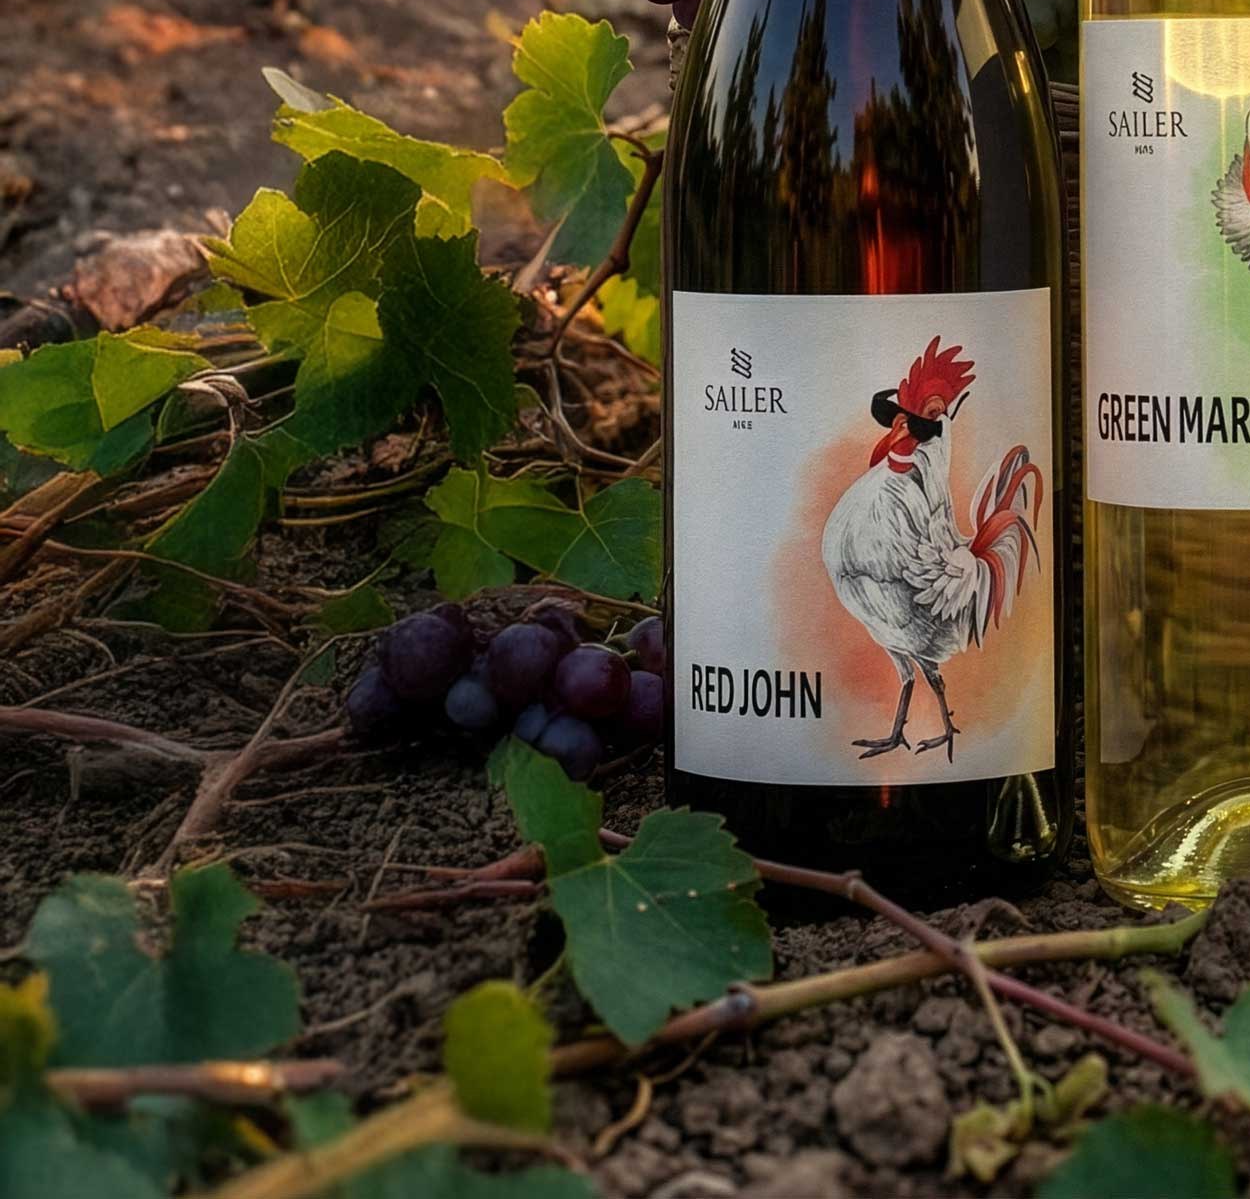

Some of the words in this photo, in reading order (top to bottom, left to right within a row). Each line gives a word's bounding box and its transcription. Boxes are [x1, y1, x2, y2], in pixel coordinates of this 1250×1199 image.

[1108, 111, 1188, 138] SAILER
[705, 385, 788, 414] SAILER
[1097, 393, 1171, 443] GREEN
[691, 664, 735, 714] RED
[739, 669, 822, 719] JOHN
